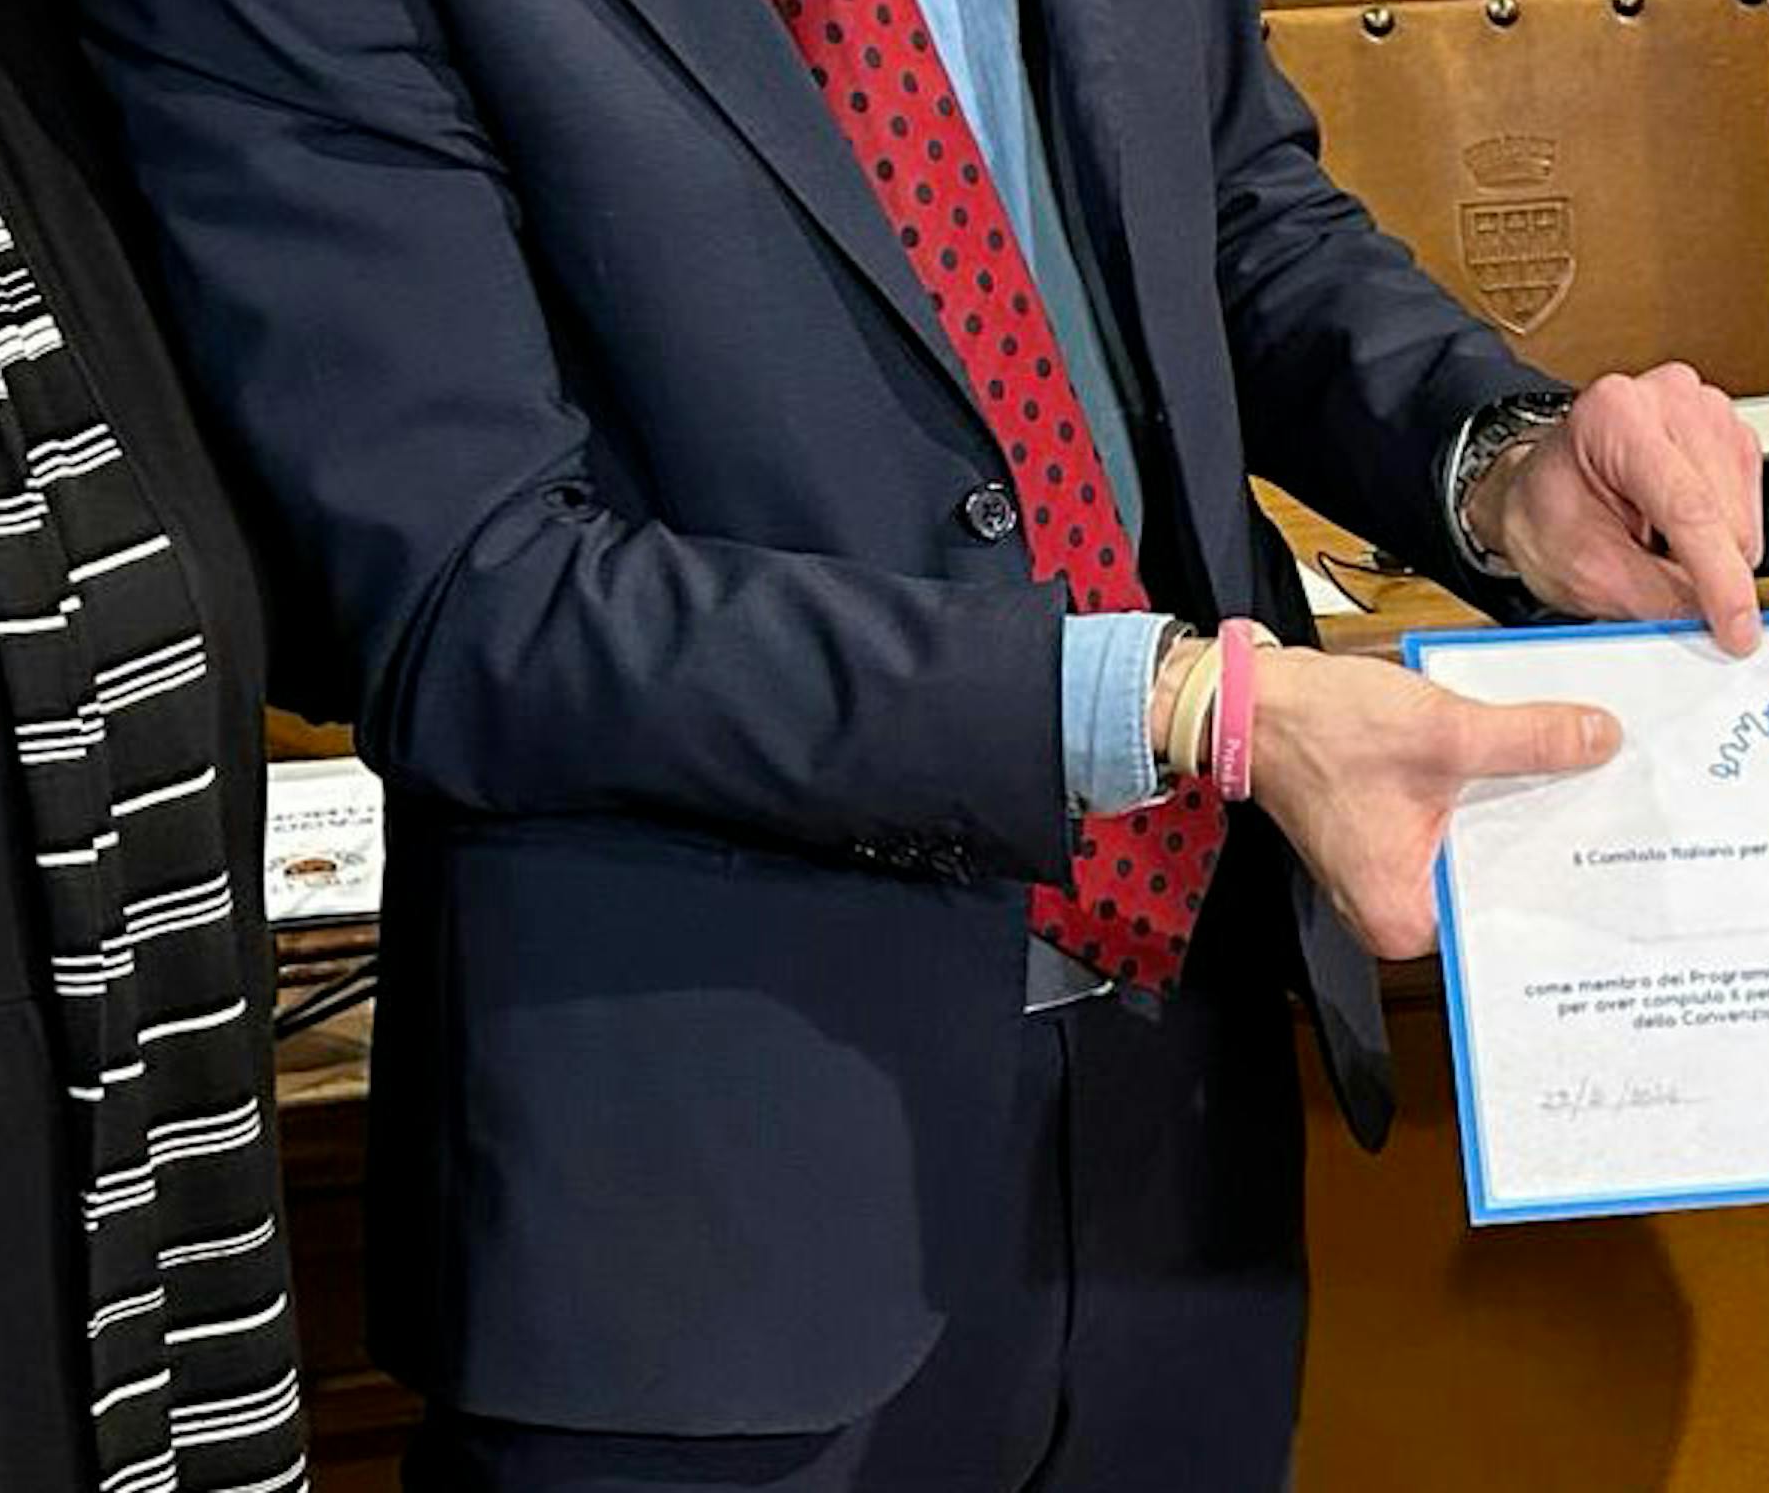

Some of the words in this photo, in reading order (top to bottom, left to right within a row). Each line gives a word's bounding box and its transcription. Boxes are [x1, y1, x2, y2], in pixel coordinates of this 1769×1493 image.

[1588, 847, 1666, 865] Comitato
[1671, 845, 1733, 859] Italiano
[1739, 843, 1767, 859] per
[1525, 982, 1572, 997] come
[1579, 975, 1652, 992] membro
[1558, 1001, 1587, 1018] per
[1595, 998, 1636, 1012] aver
